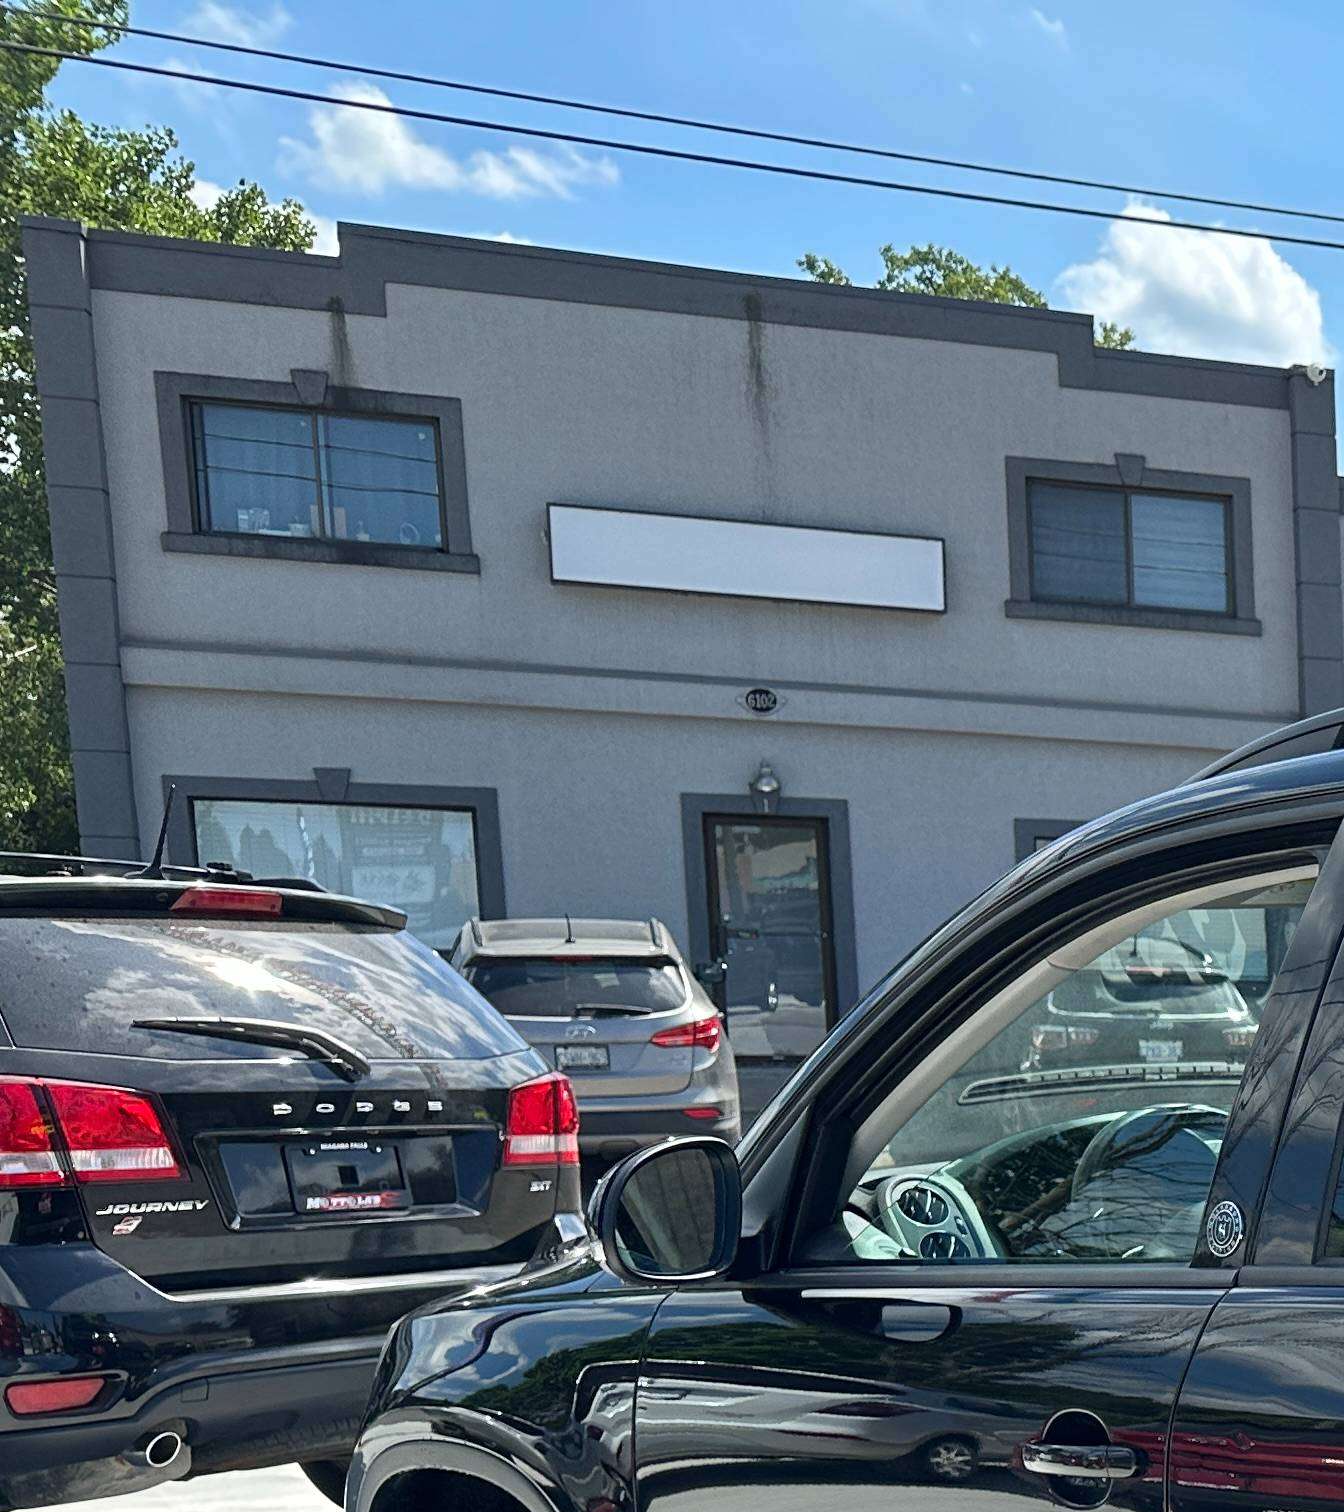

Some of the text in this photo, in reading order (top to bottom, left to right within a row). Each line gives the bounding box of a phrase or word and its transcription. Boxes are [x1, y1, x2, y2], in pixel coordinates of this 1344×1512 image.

[747, 693, 776, 710] 6102
[273, 1099, 443, 1116] DODGE
[95, 1199, 209, 1216] JOURNEY
